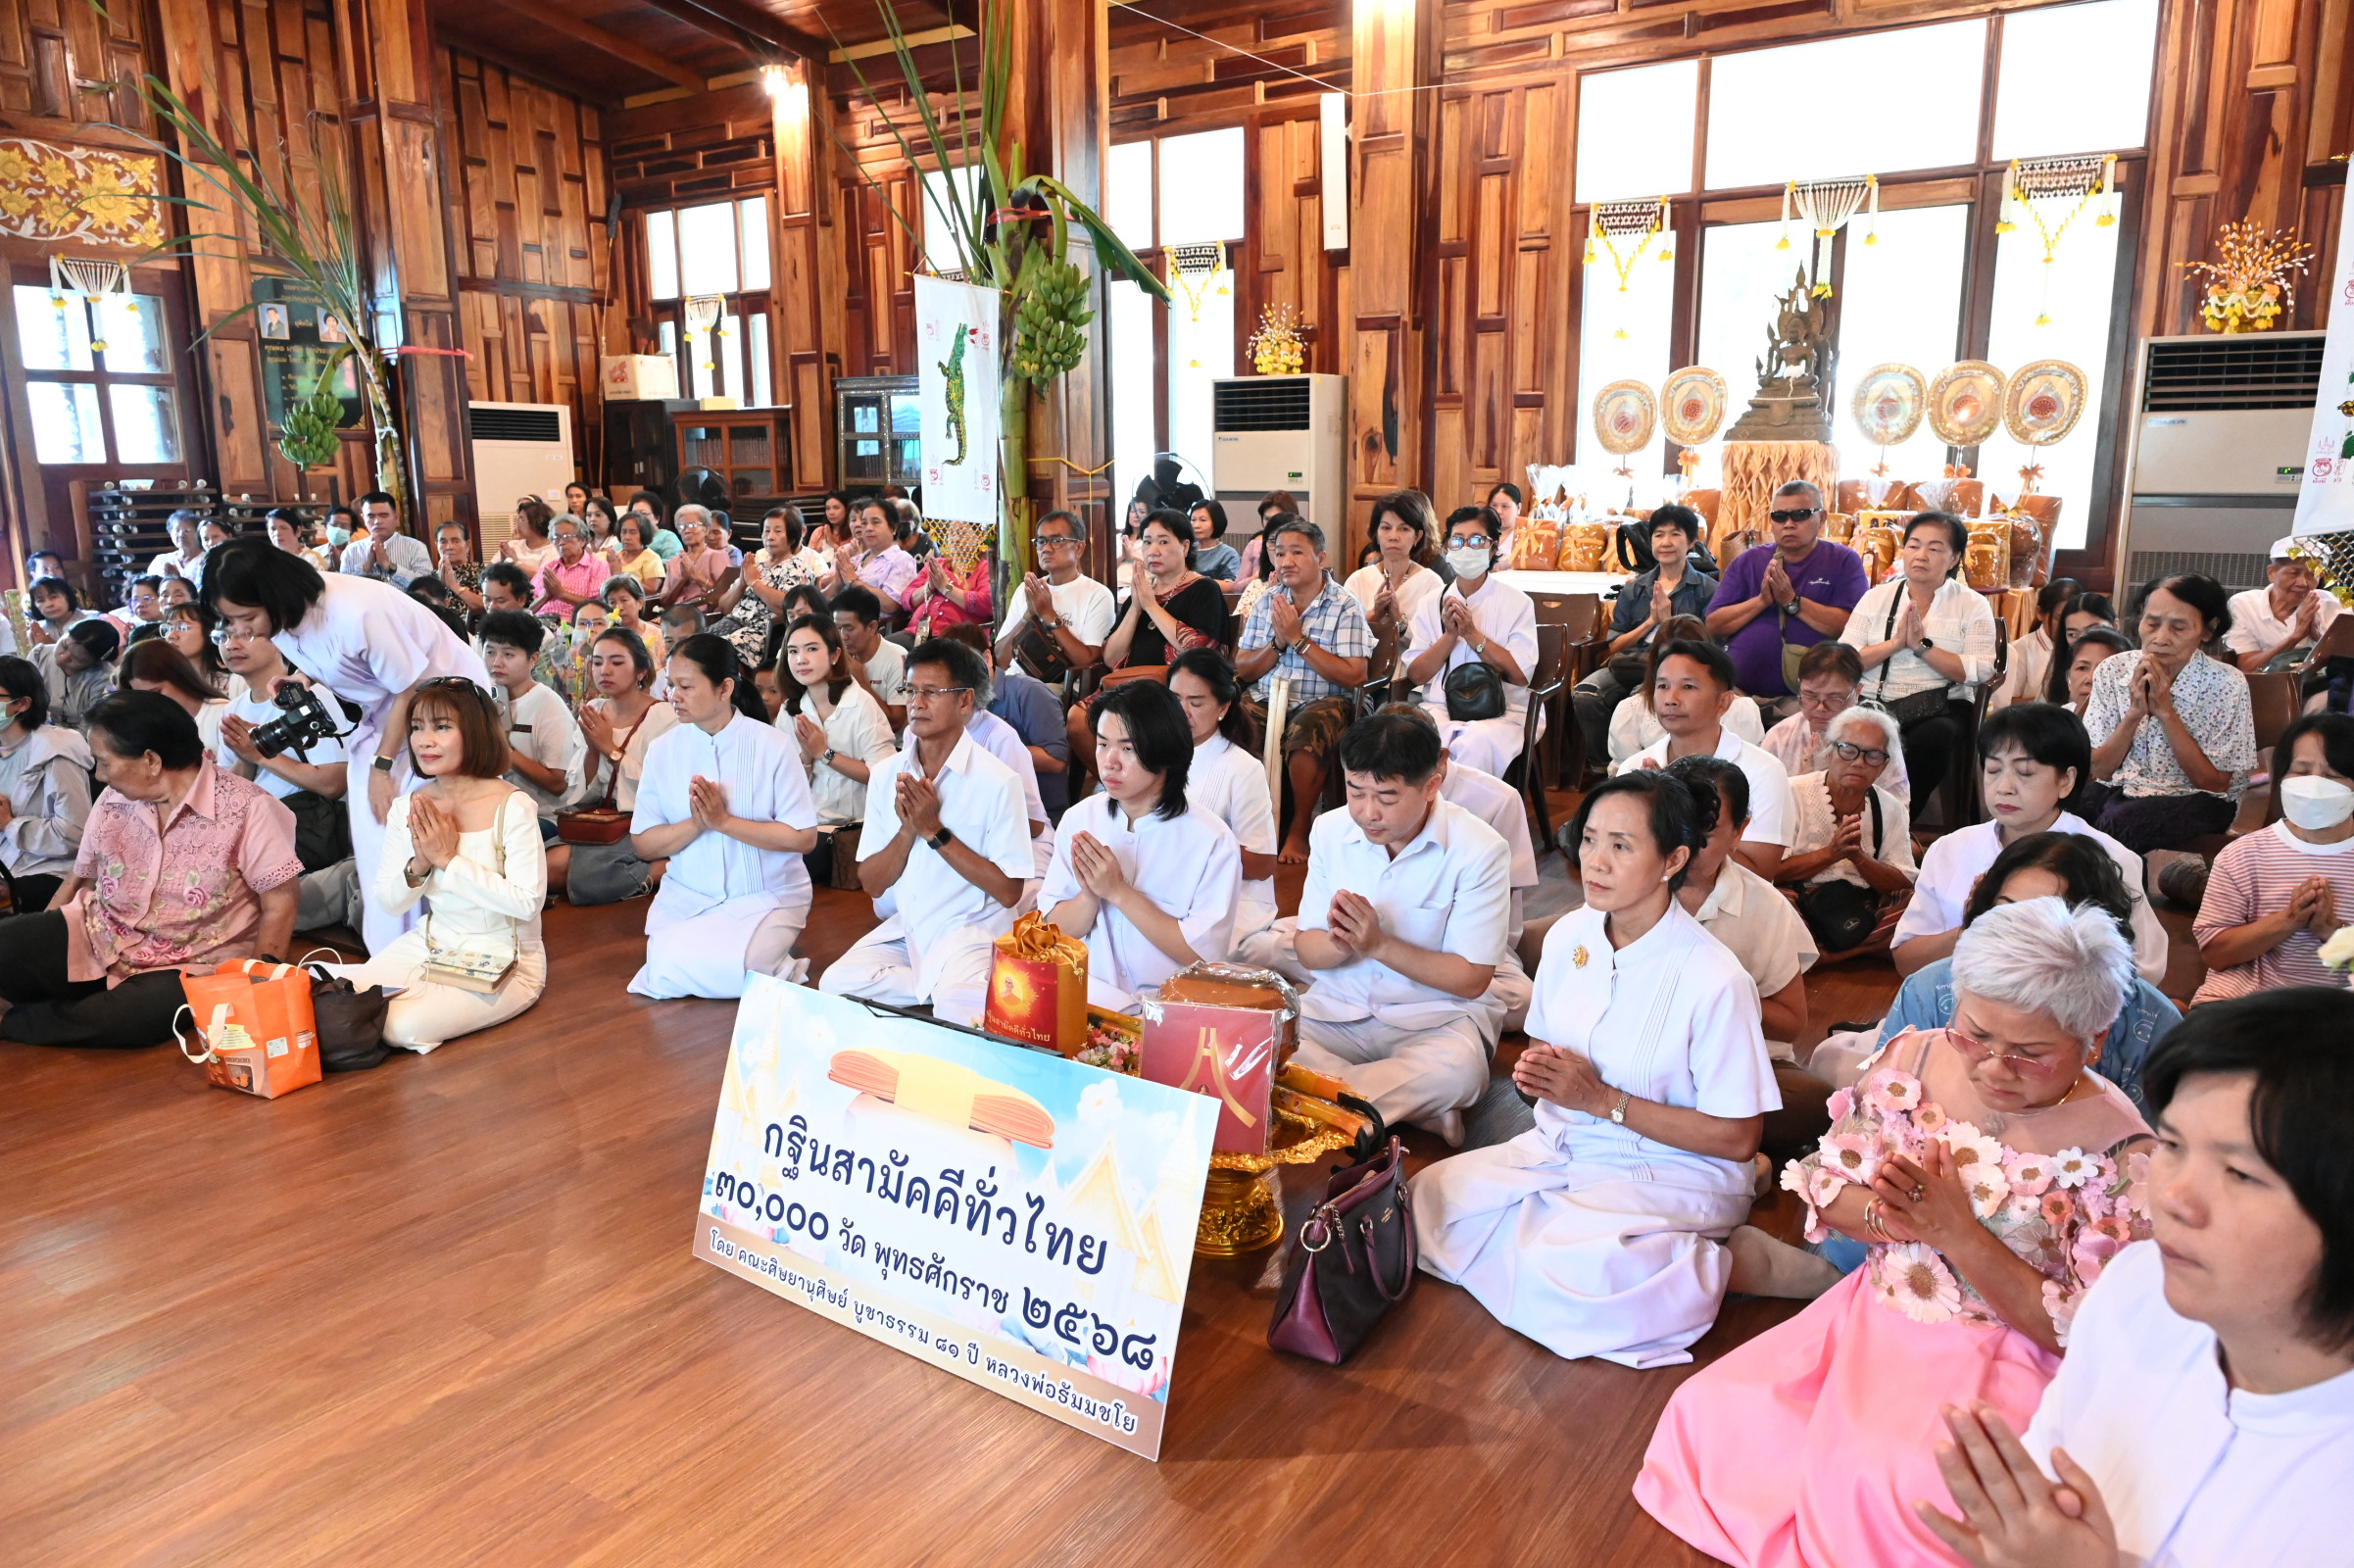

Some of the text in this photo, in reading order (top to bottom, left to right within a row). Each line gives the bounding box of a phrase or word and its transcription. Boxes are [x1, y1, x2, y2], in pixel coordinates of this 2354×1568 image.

[714, 1171, 1157, 1371] ๓๐,๐๐๐ วัด พุทธศักราช ๒๕๖๘
[764, 1114, 1107, 1275] กฐินสามัคคีทั่วไทย
[711, 1229, 1135, 1433] โดย คณะศิษยานุศิษย์ บูชาธรรม ๘๑ ปี หลวงพ่อธัมมชโย
